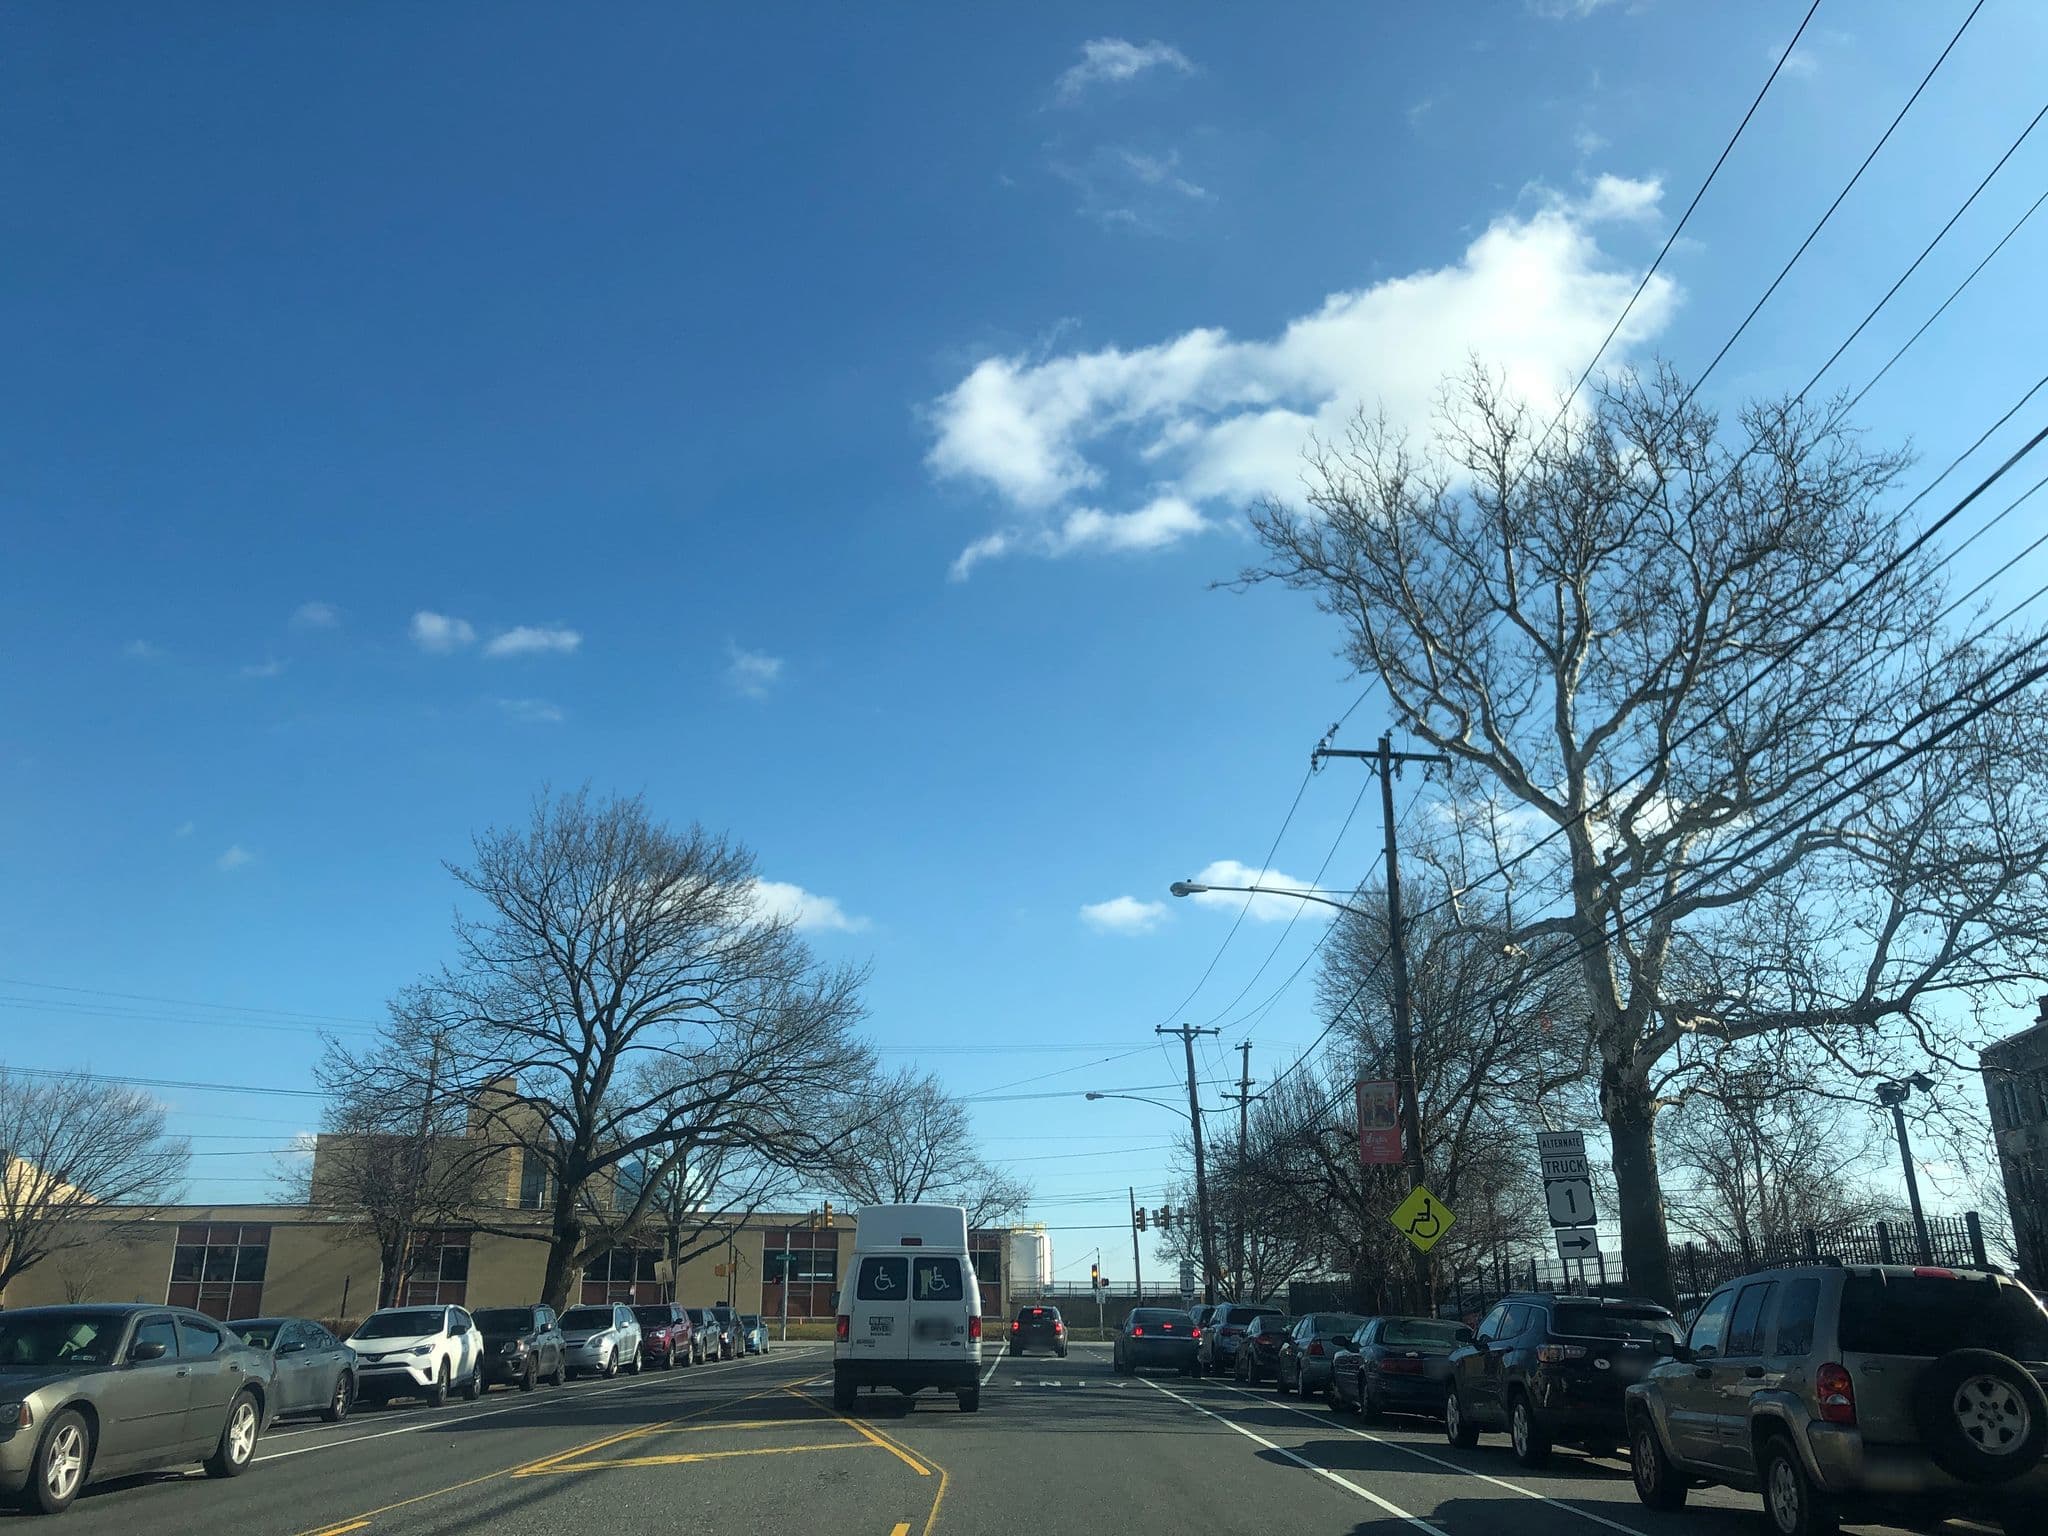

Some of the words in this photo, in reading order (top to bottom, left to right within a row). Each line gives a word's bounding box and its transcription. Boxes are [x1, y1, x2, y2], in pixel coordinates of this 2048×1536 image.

[1542, 1137, 1582, 1149] ALTERNATE
[1544, 1159, 1585, 1174] TRUCK
[1564, 1188, 1577, 1214] 1
